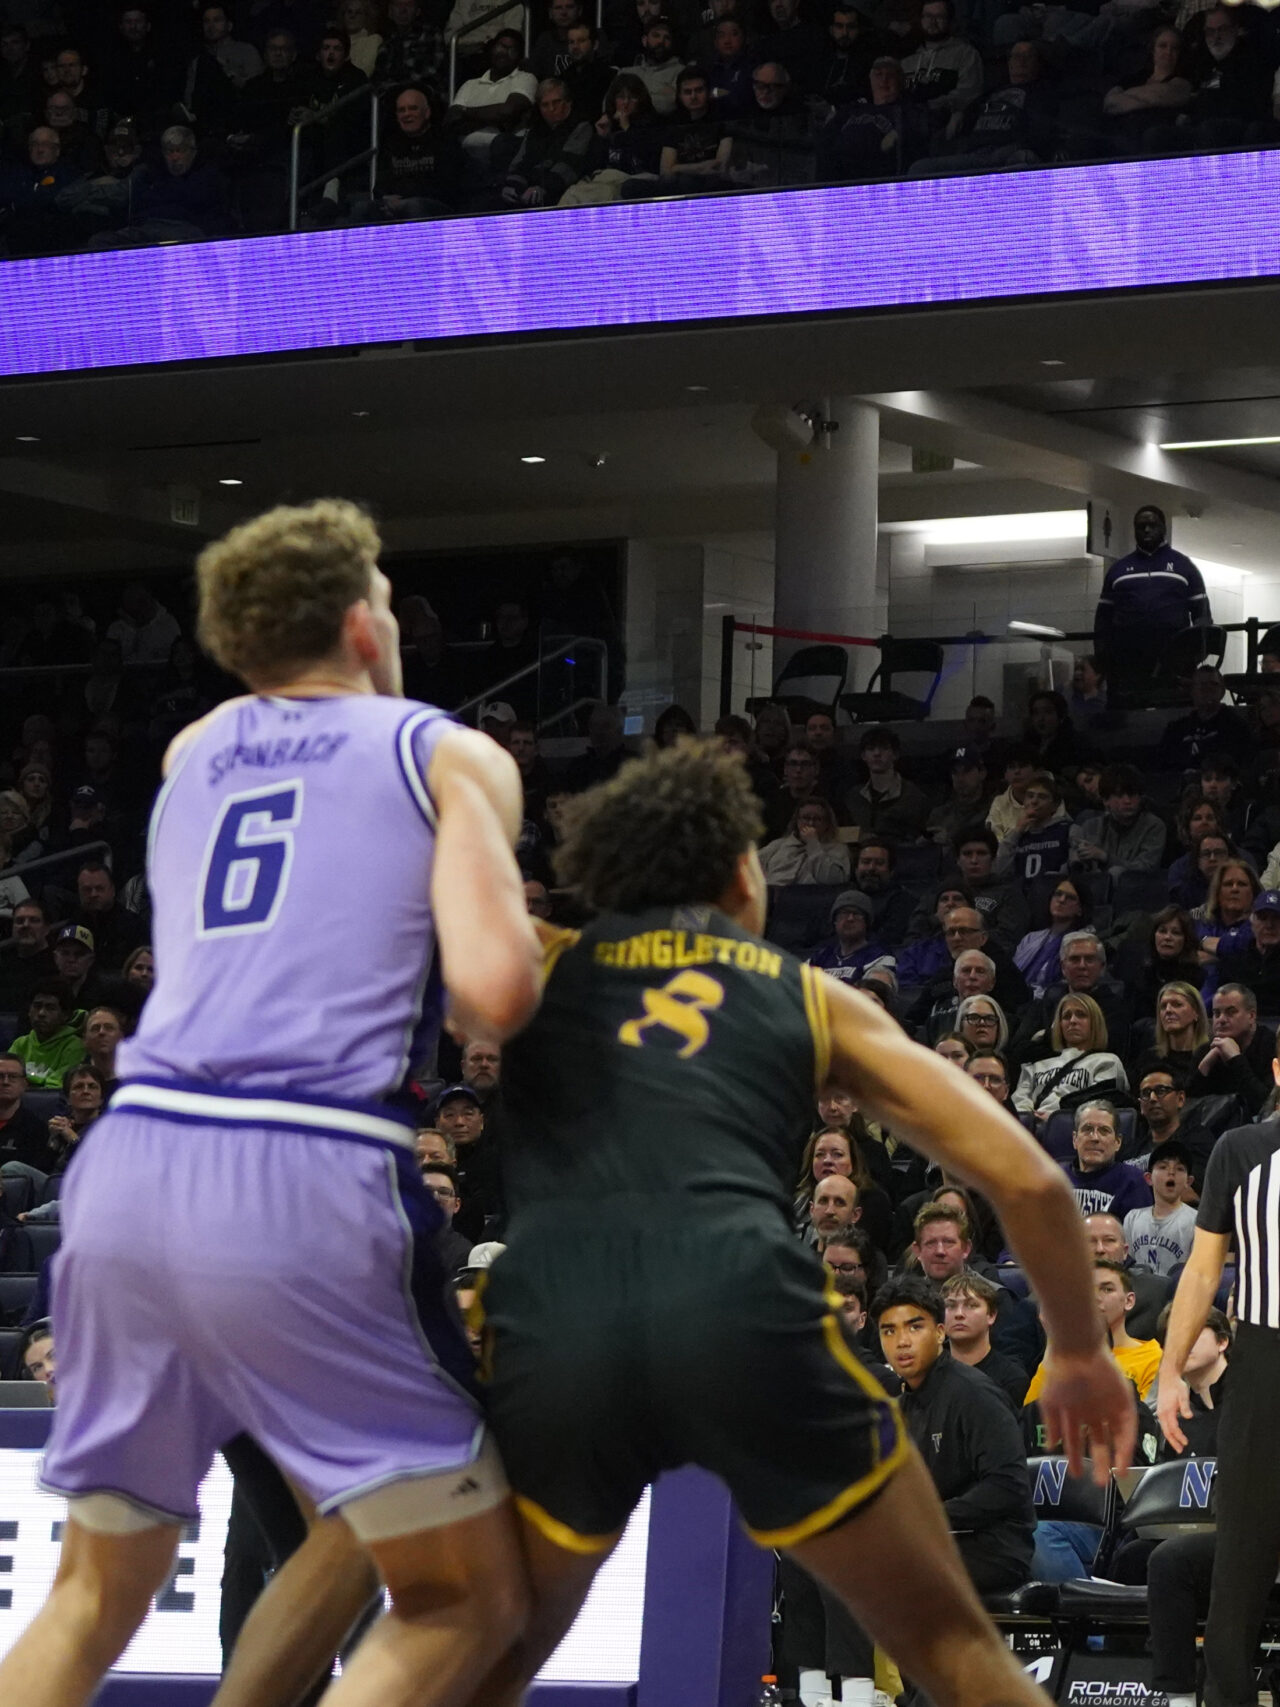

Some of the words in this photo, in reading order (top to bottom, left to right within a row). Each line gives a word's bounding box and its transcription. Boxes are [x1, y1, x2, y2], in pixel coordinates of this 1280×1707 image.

[198, 777, 304, 941] 6
[1033, 1459, 1070, 1506] N
[1179, 1461, 1217, 1508] N
[1070, 1696, 1147, 1707] AUTOMOTIVE
